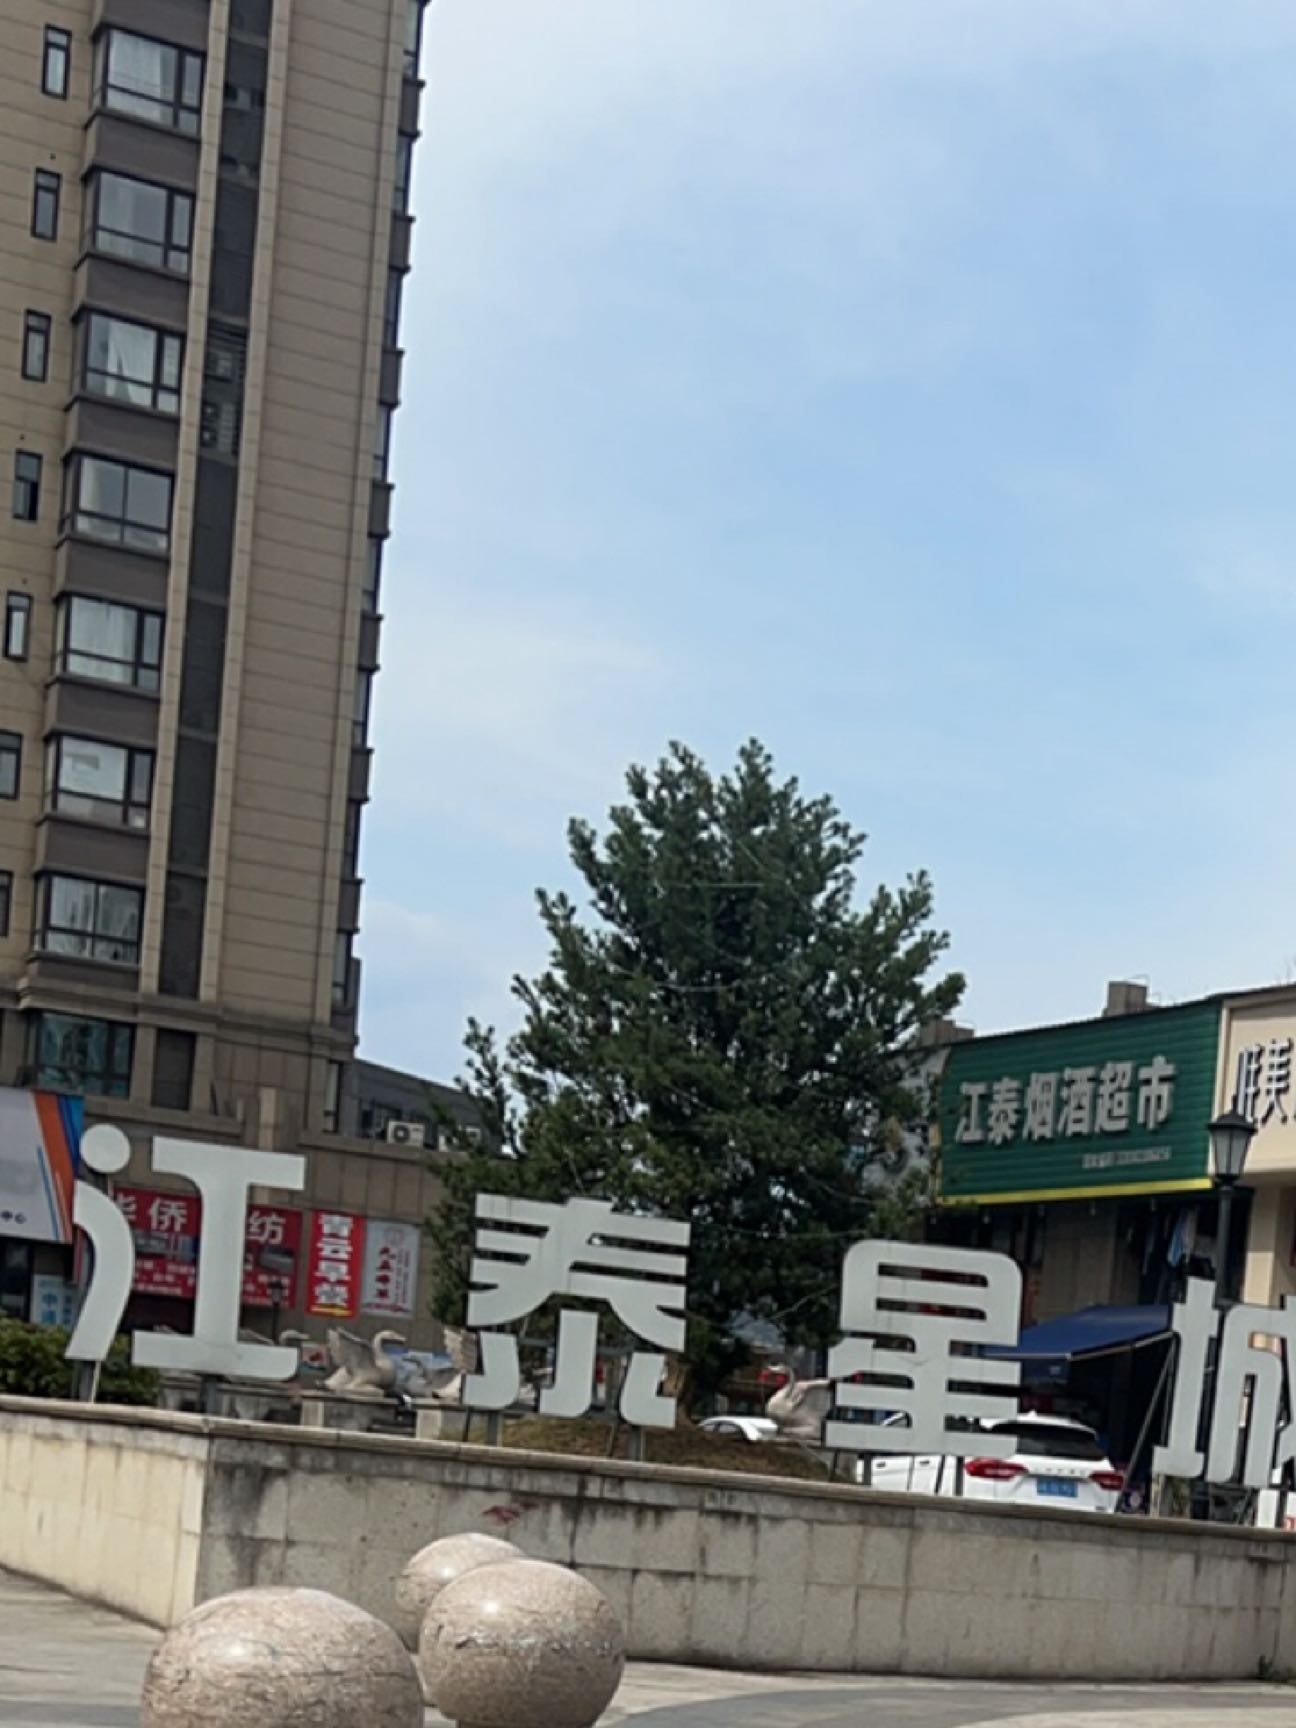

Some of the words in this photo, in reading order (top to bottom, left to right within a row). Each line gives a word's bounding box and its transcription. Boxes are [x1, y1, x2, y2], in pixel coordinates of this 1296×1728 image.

[956, 1055, 1177, 1145] 江泰烟酒超市
